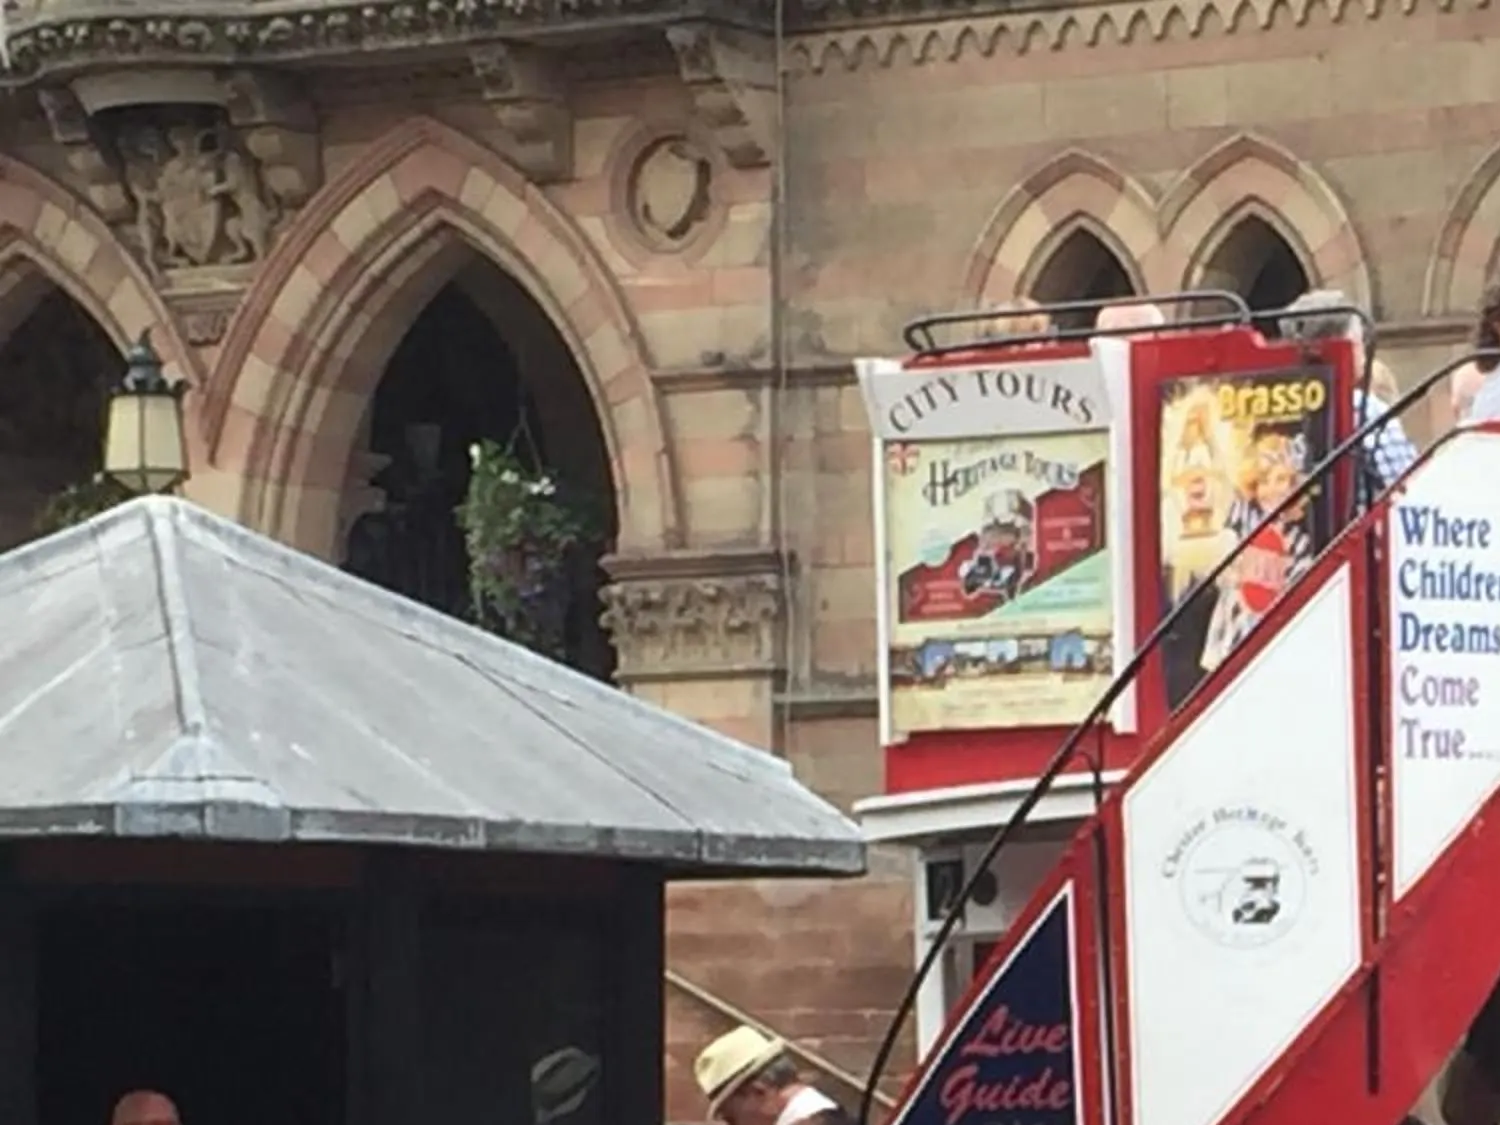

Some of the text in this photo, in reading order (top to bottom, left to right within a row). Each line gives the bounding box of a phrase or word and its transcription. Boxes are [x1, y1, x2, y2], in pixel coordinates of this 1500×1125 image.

[888, 369, 1096, 433] CITY TOURS
[1217, 378, 1326, 419] Brasso
[1398, 505, 1492, 549] Where
[1399, 665, 1480, 707] Come
[962, 1004, 1069, 1057] Live
